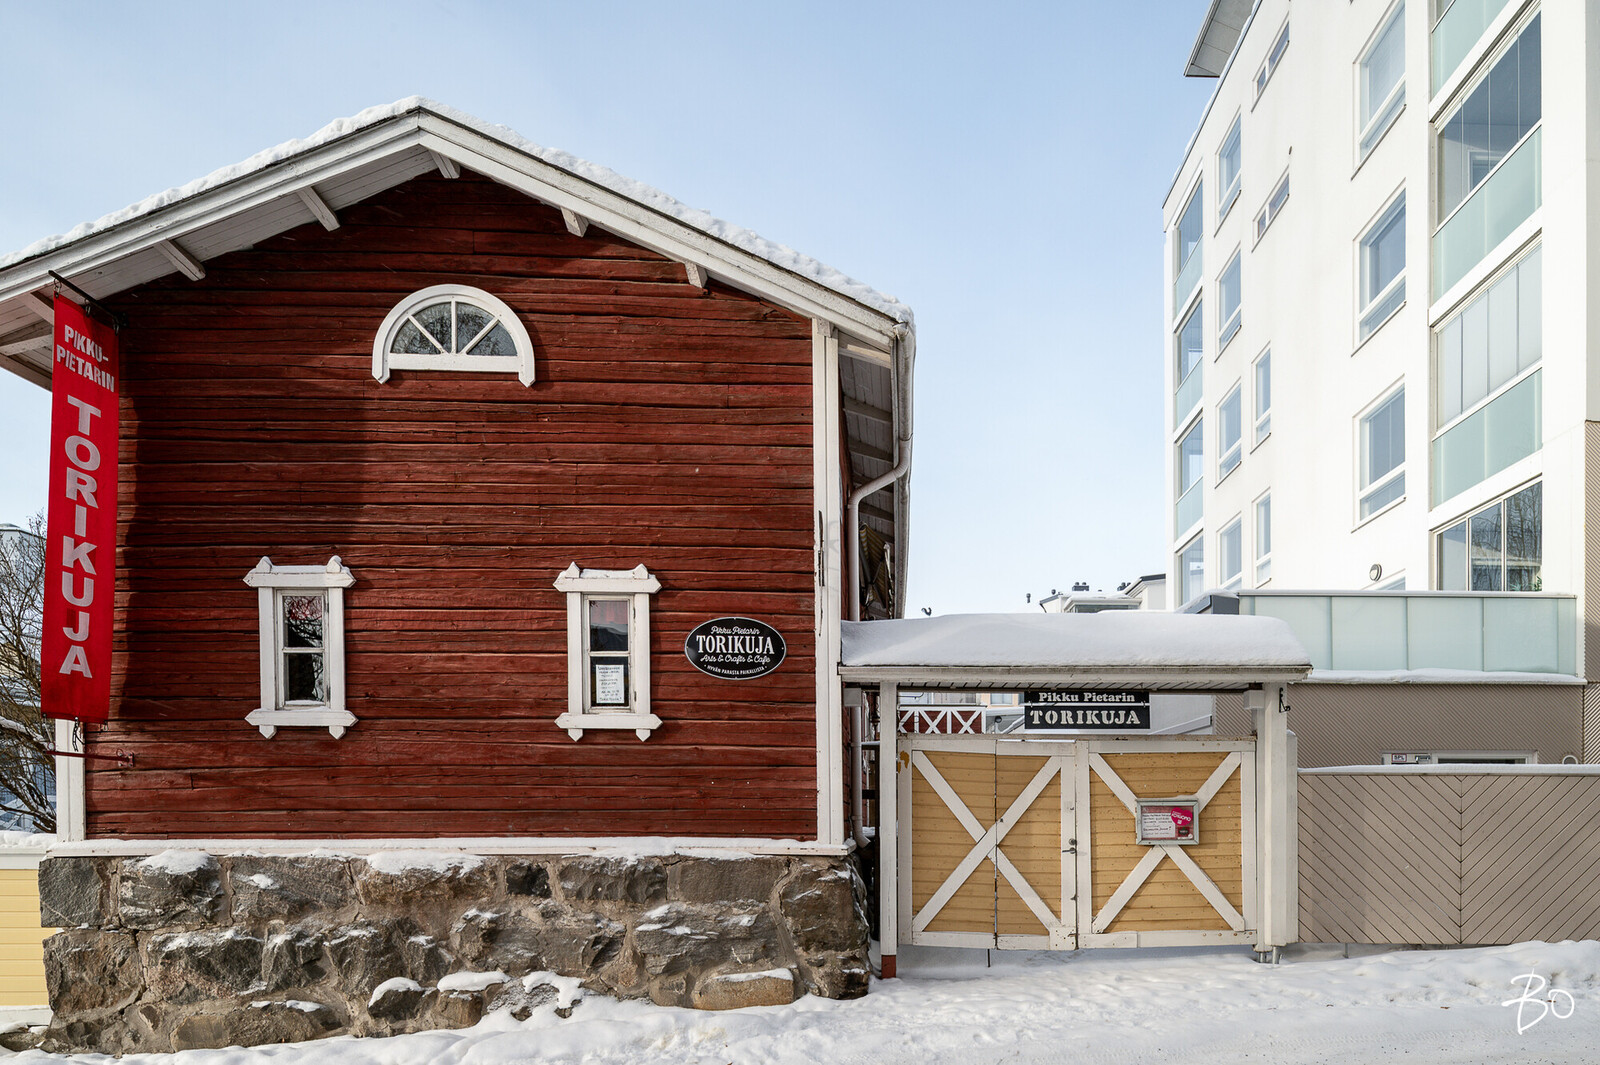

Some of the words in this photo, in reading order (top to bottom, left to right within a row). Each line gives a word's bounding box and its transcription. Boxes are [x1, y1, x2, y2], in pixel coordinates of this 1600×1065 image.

[64, 324, 109, 362] PIKKU-
[56, 344, 114, 392] PIETARIN
[58, 394, 102, 679] TORIKUJA
[710, 625, 732, 634] Pikku
[732, 626, 760, 635] Pietarin
[696, 634, 775, 655] TORIKUJA
[700, 654, 717, 662] Arts
[717, 654, 724, 662] &
[724, 654, 746, 665] Crafts
[747, 655, 754, 663] &
[1039, 692, 1079, 702] Pikku
[1083, 692, 1135, 702] Pietarin
[1029, 710, 1141, 725] TORIKUJA
